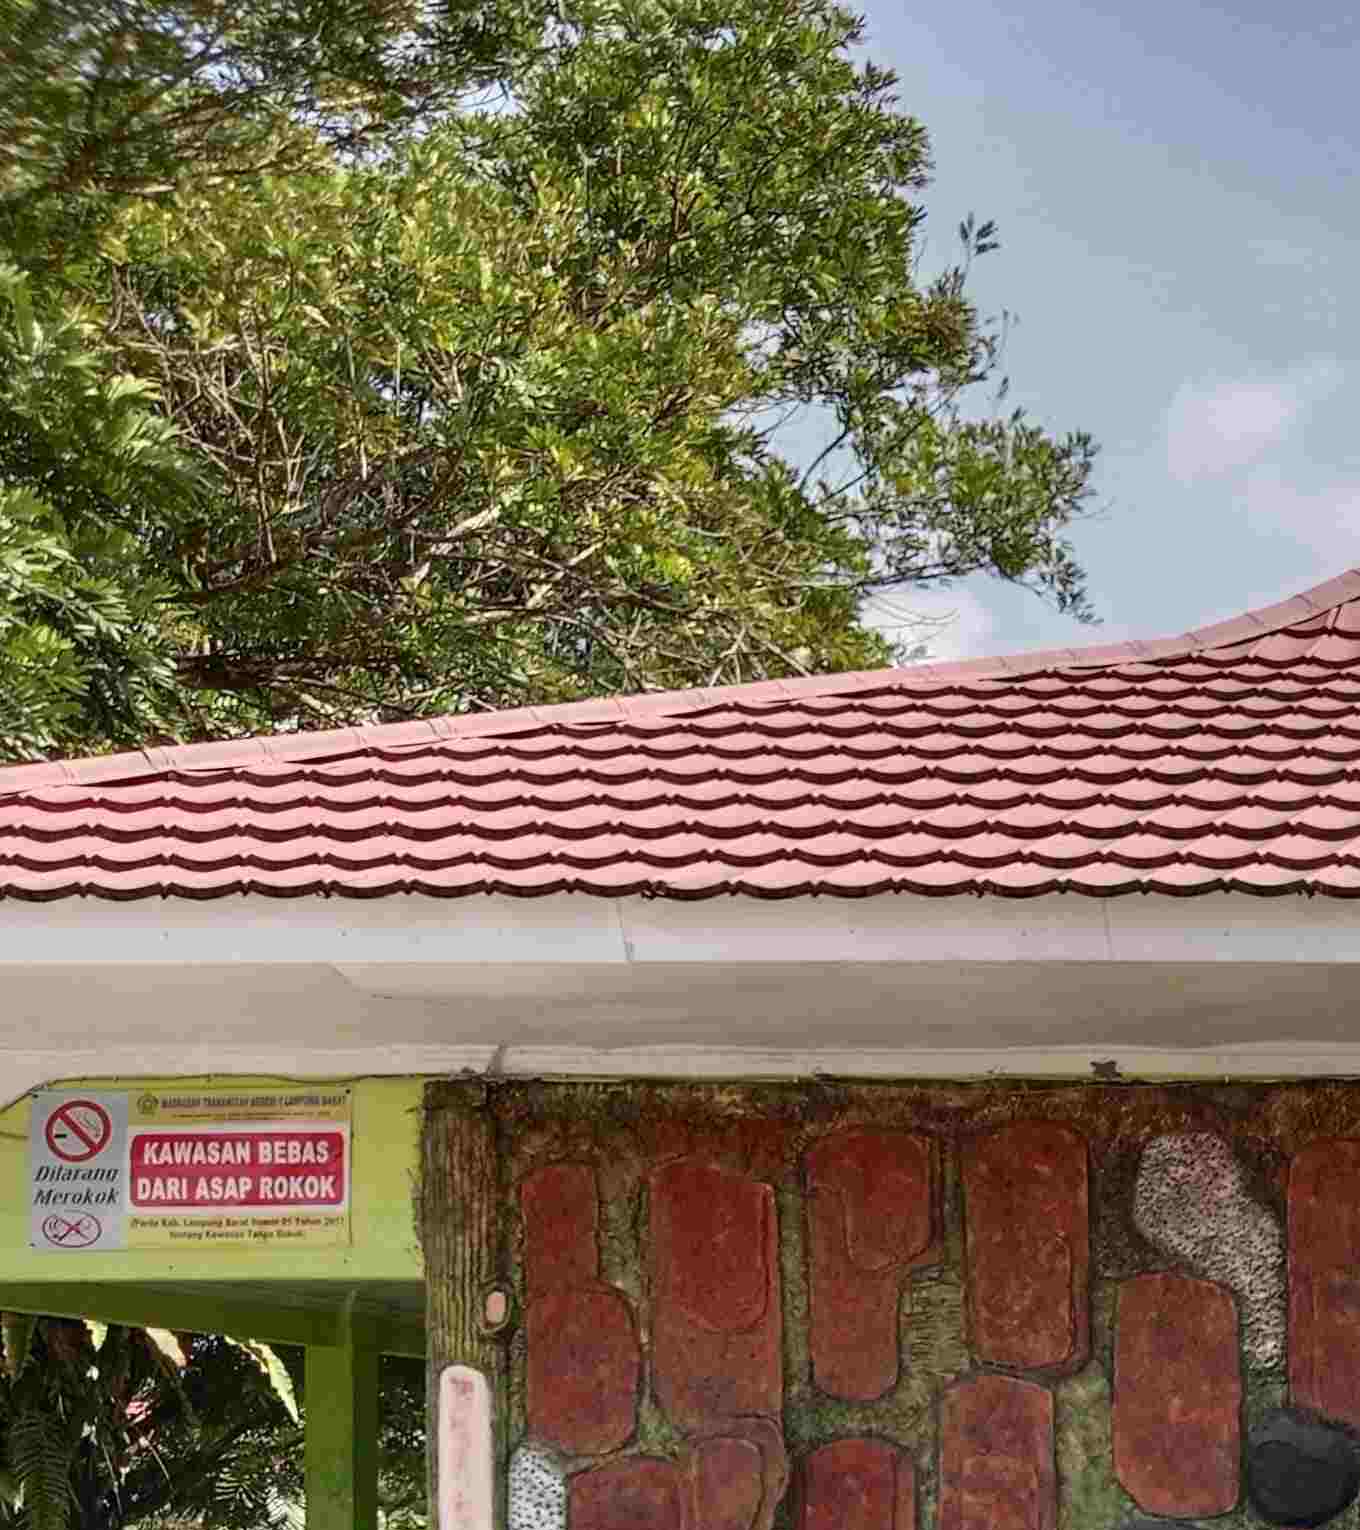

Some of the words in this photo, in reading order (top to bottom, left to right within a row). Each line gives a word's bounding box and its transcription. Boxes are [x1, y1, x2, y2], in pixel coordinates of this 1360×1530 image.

[143, 1141, 250, 1166] KAWASAN
[258, 1140, 329, 1165] BEBAS
[34, 1164, 120, 1184] Dilarang
[33, 1187, 120, 1206] Merokok
[137, 1177, 188, 1201] DARI
[195, 1176, 252, 1200] ASAP
[259, 1175, 336, 1199] ROKOK
